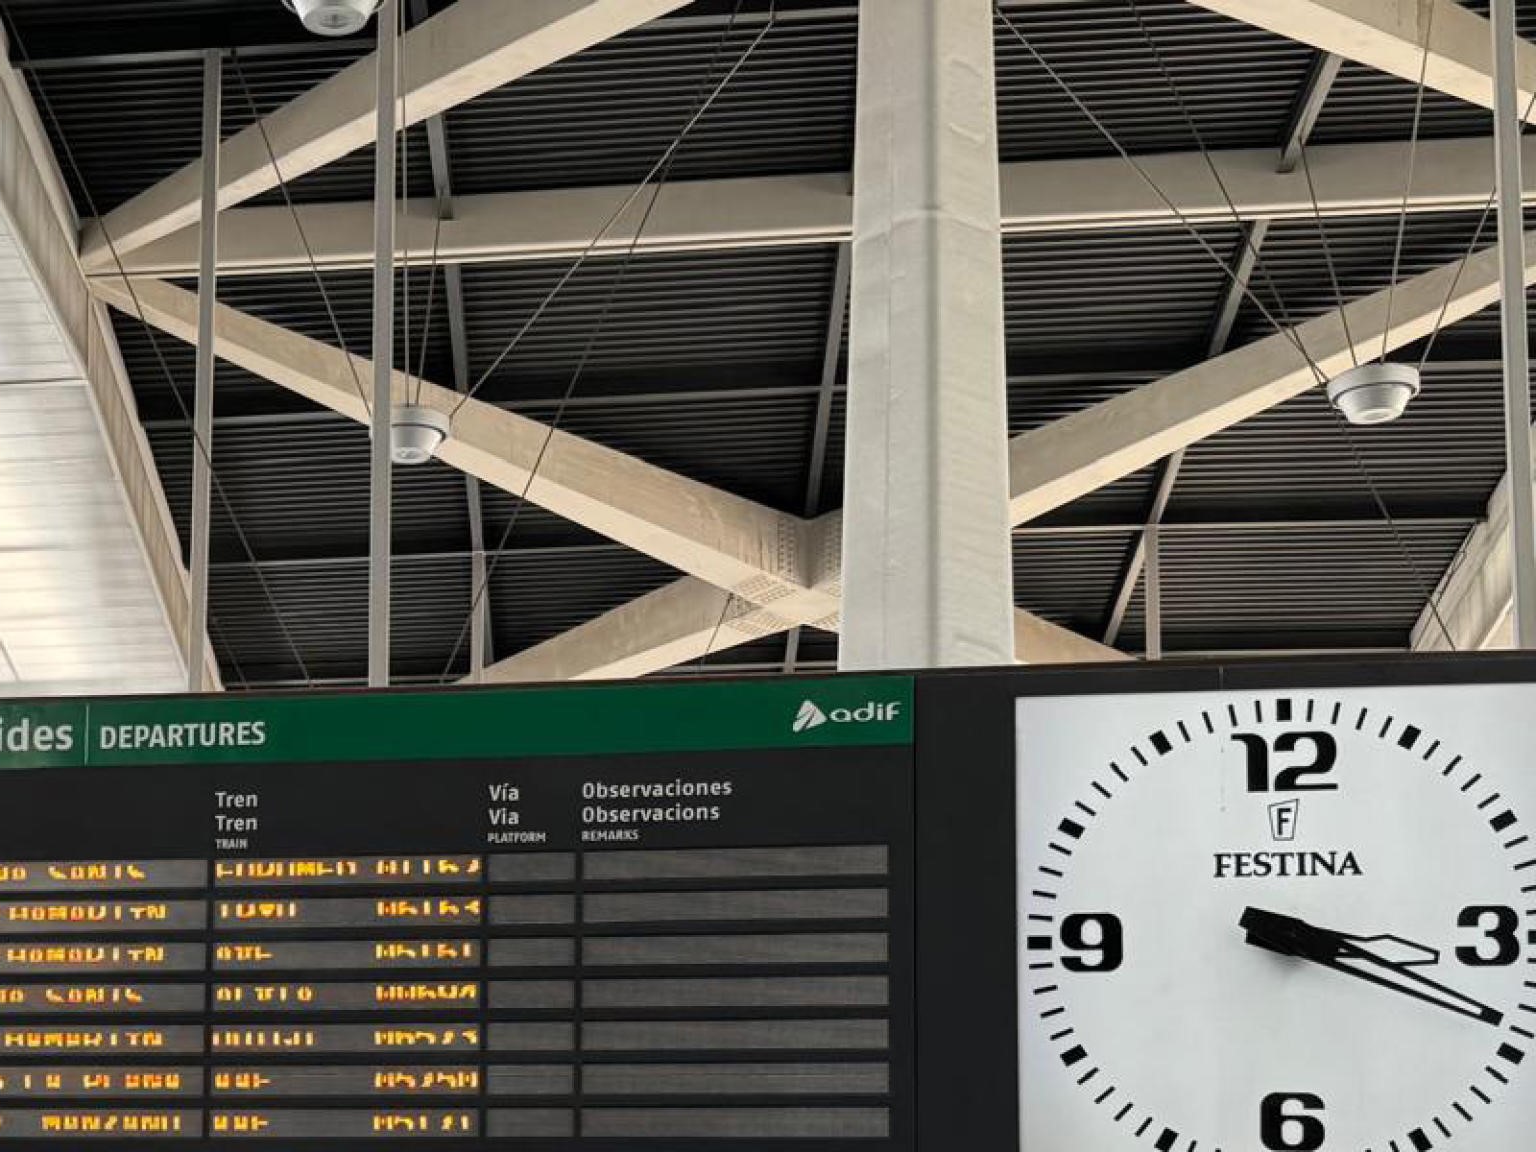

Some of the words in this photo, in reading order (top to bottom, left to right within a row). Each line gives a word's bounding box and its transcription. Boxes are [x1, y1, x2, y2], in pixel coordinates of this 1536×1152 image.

[829, 700, 902, 723] adif
[99, 721, 266, 750] DEPARTURES
[1230, 730, 1339, 793] 12
[214, 791, 258, 808] Tren
[488, 783, 520, 801] Vía
[581, 779, 733, 799] Observaciones
[214, 815, 258, 831] Tren
[581, 803, 721, 823] Observacions
[1276, 807, 1293, 836] F
[214, 838, 249, 850] TRAIN
[487, 832, 546, 844] PLATFORM
[581, 829, 640, 842] REMARKS
[1213, 850, 1364, 878] FESTINA
[1058, 912, 1124, 973] 9
[1455, 905, 1521, 967] 3
[1259, 1091, 1326, 1152] 6
